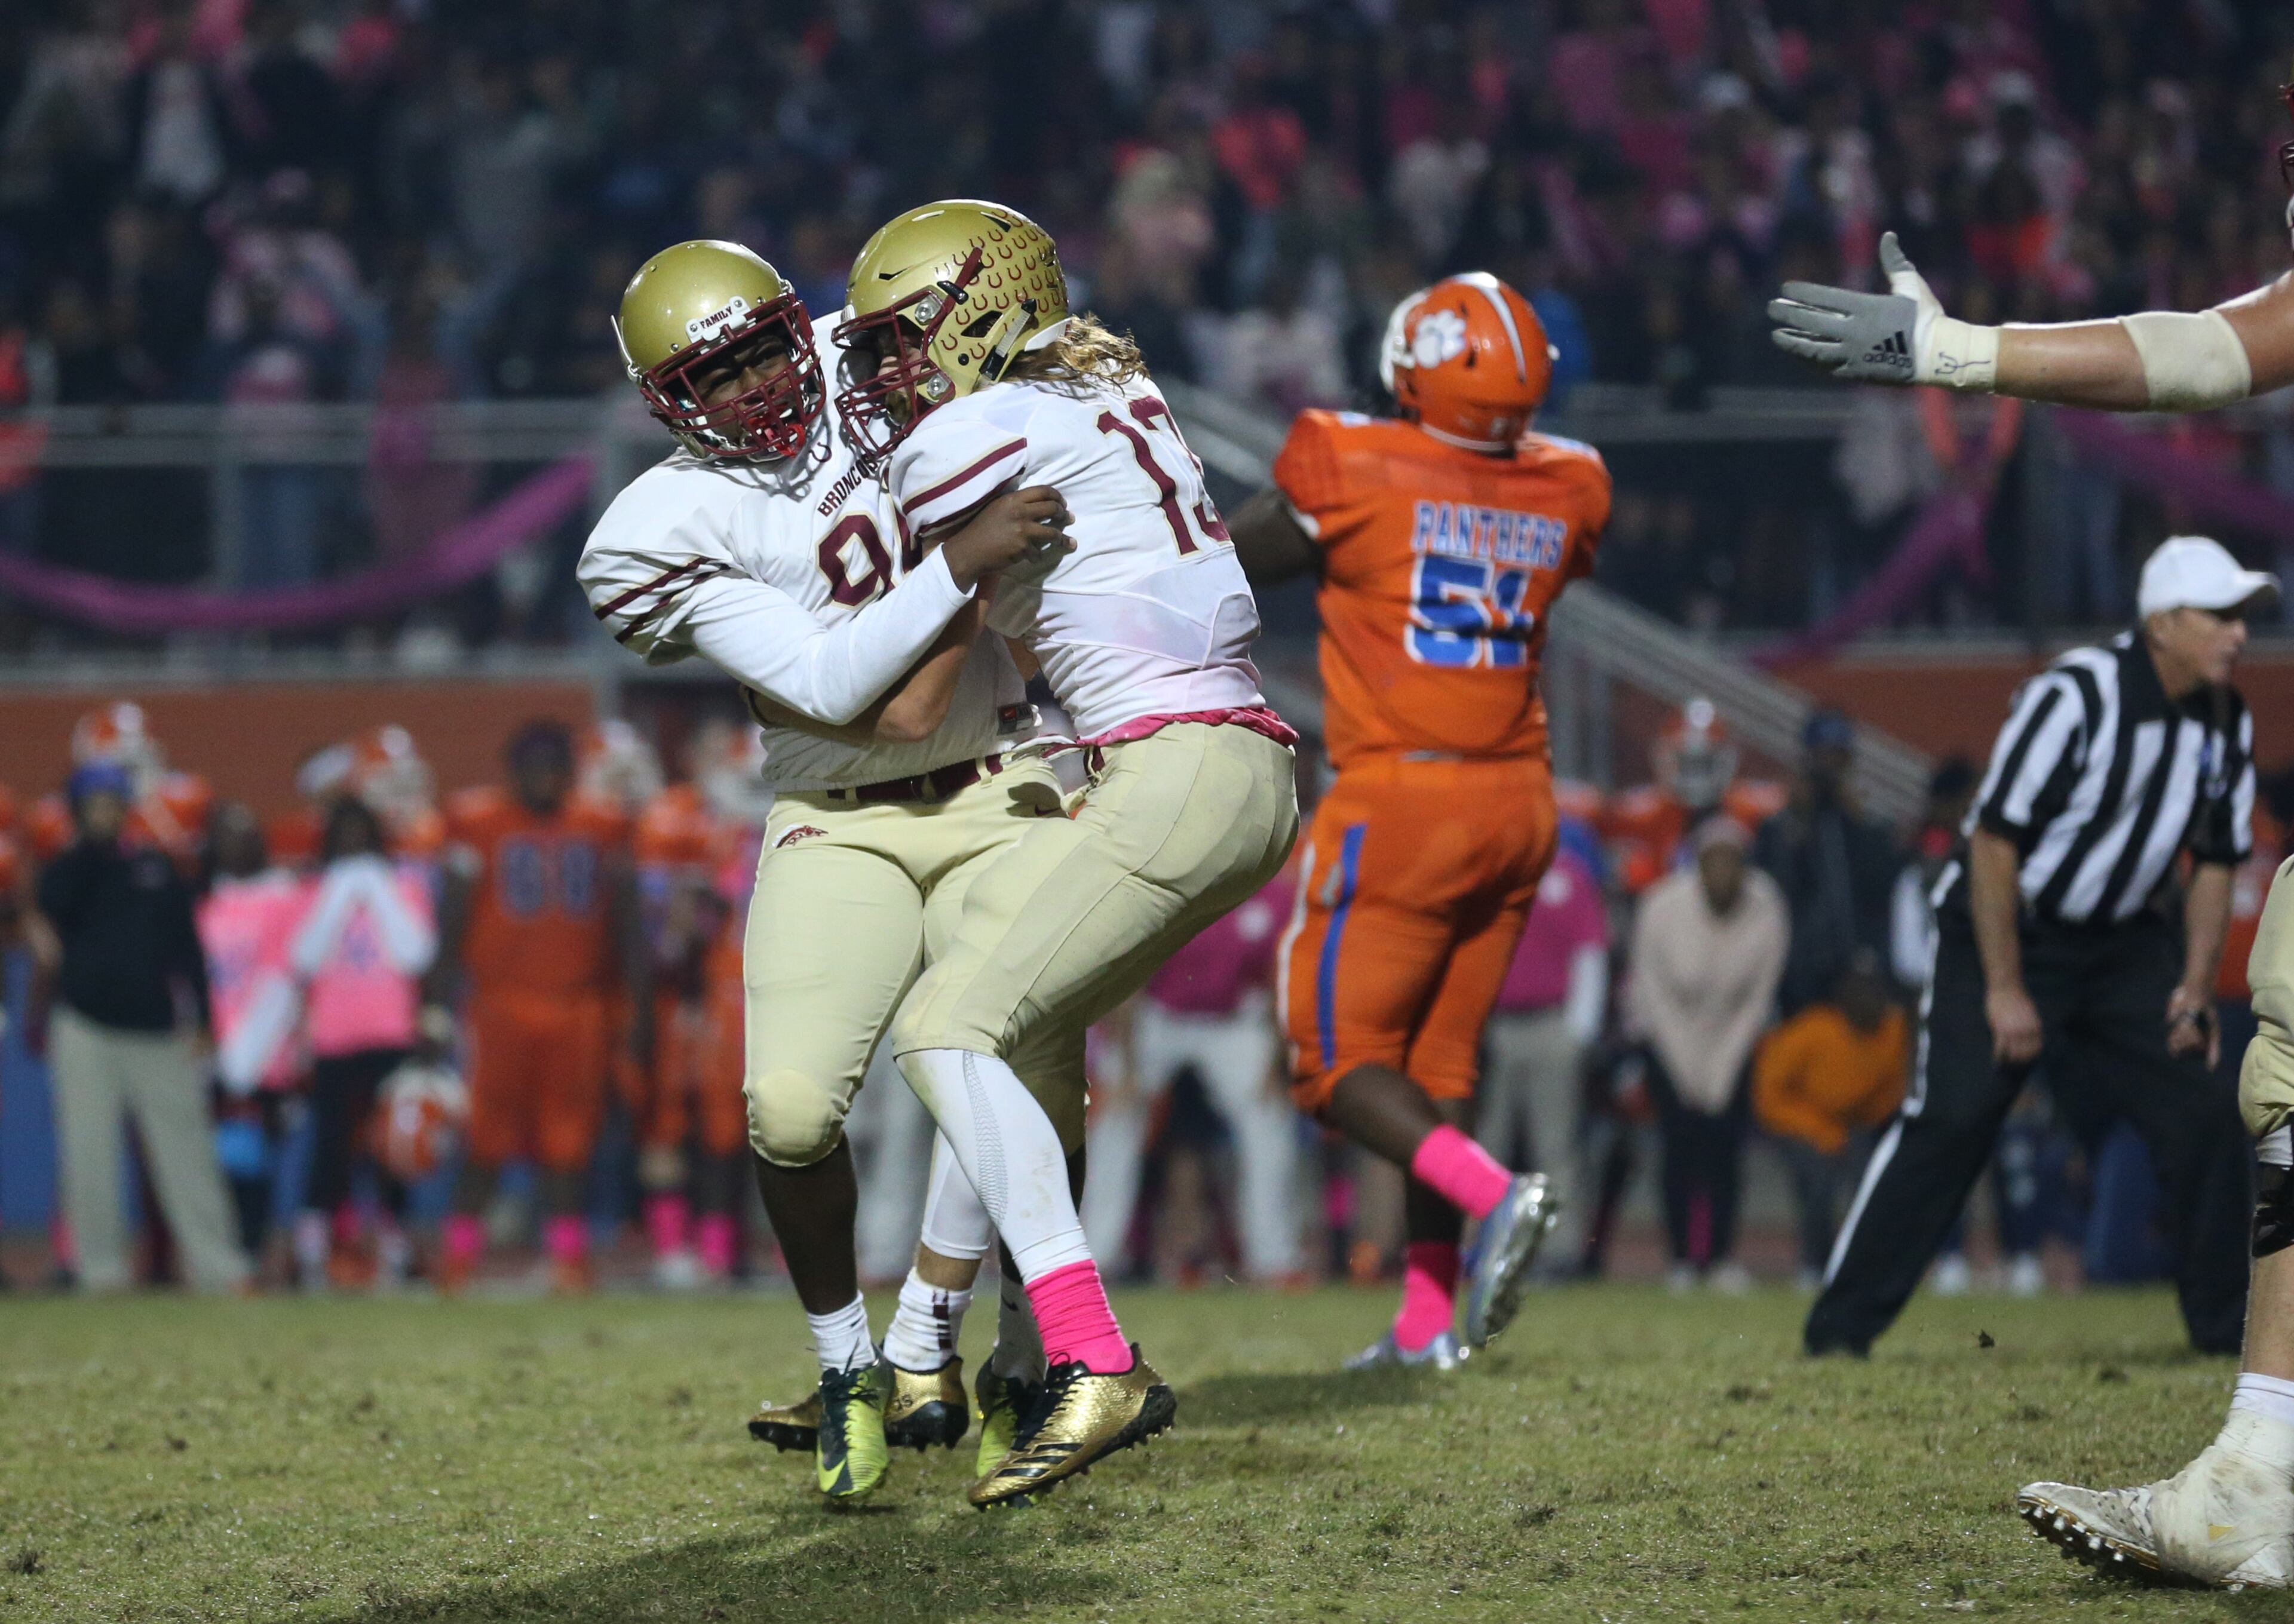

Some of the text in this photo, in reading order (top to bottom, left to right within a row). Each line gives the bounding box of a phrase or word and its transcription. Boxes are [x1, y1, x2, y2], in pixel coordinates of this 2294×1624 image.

[700, 306, 732, 329] FAMILY
[1410, 500, 1567, 570] PANTHERS
[1403, 552, 1534, 669] 51
